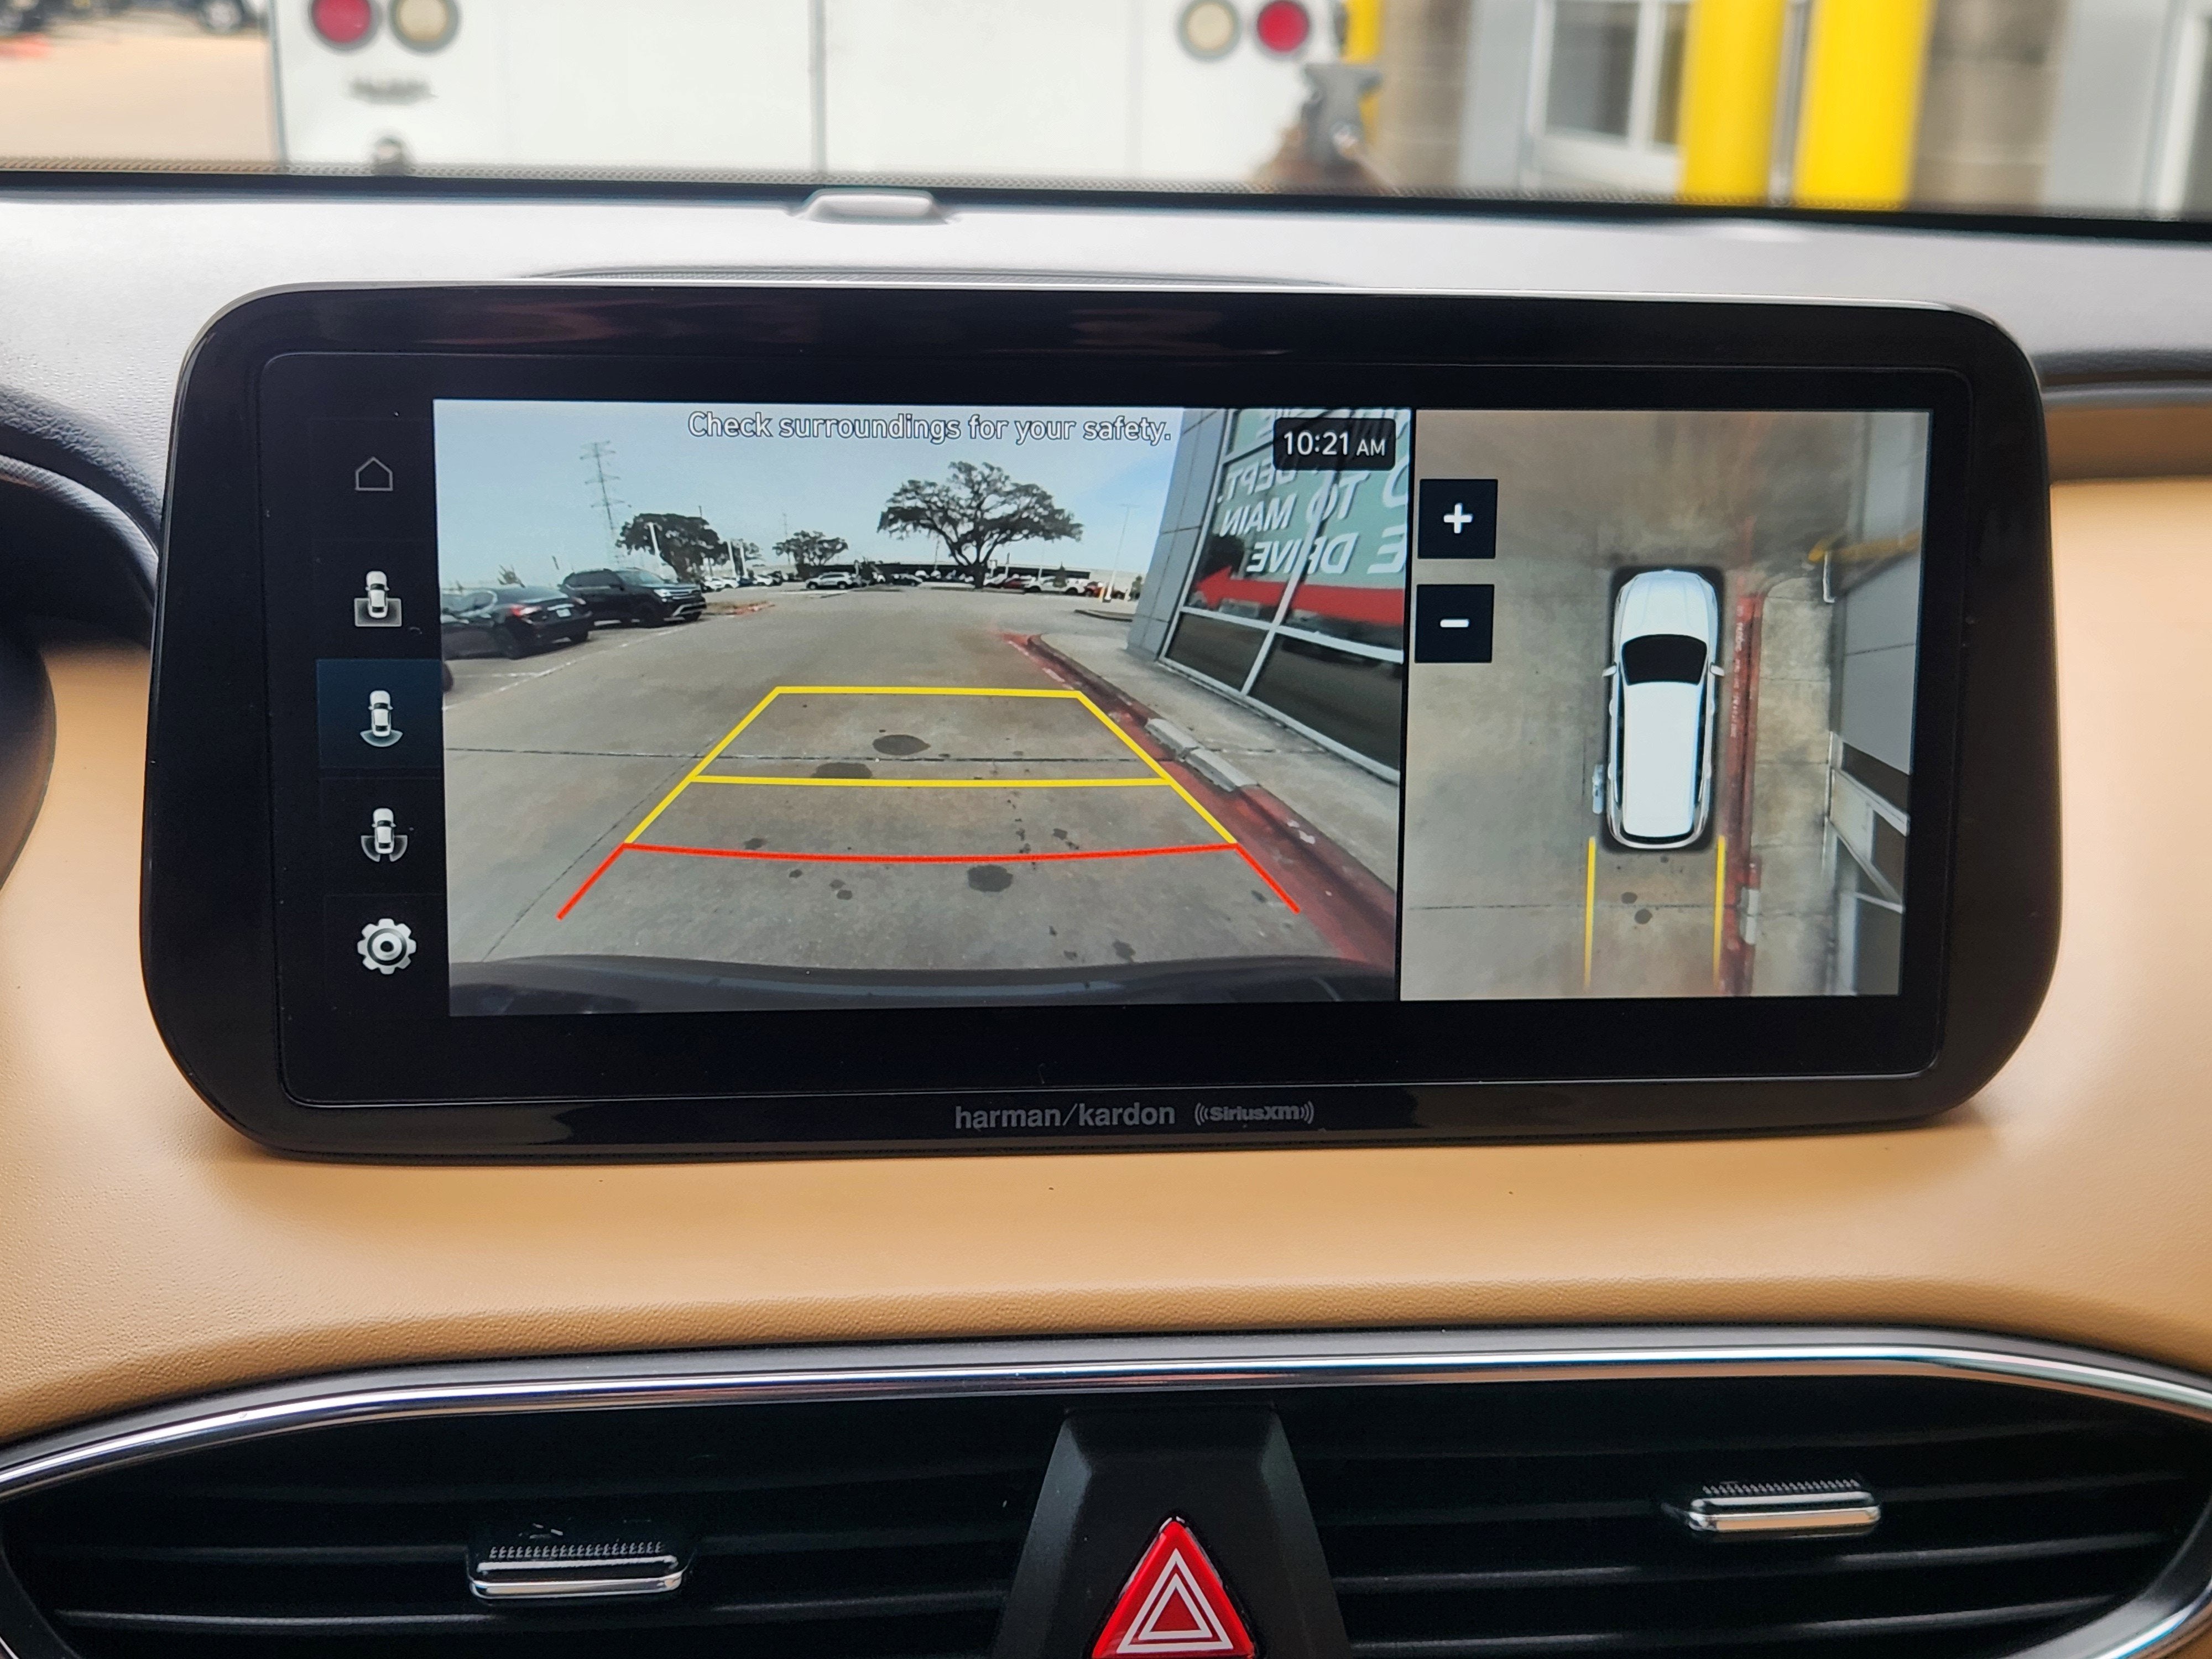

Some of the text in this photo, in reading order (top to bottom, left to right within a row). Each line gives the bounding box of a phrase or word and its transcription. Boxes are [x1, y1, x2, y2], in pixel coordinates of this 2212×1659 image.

[687, 410, 1172, 446] Check surroundings for your safety.
[1284, 431, 1386, 456] 10:21 AM
[955, 1102, 1176, 1129] harman/kardon
